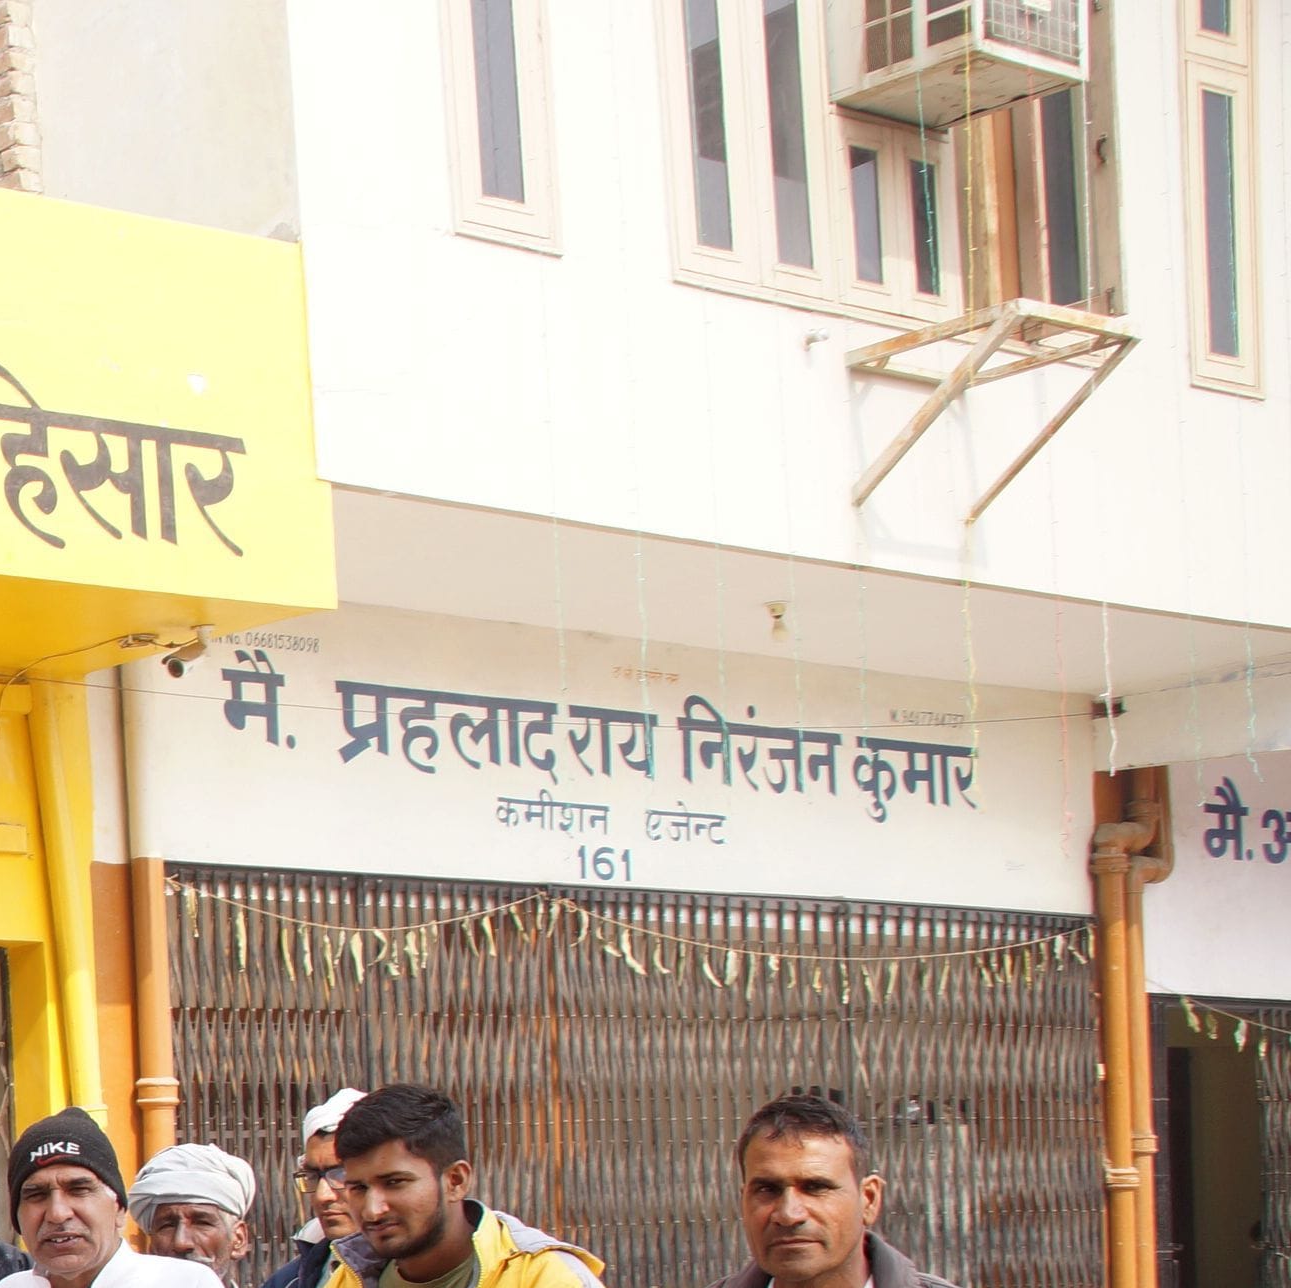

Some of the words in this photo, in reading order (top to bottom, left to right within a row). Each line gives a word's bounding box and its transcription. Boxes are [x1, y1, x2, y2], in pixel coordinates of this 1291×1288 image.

[677, 694, 843, 797] निरंजन
[853, 735, 978, 824] कुमार
[496, 789, 610, 838] कमीशन
[645, 800, 727, 845] एजेन्ट
[577, 844, 632, 882] 161
[29, 1141, 81, 1162] NIKE
